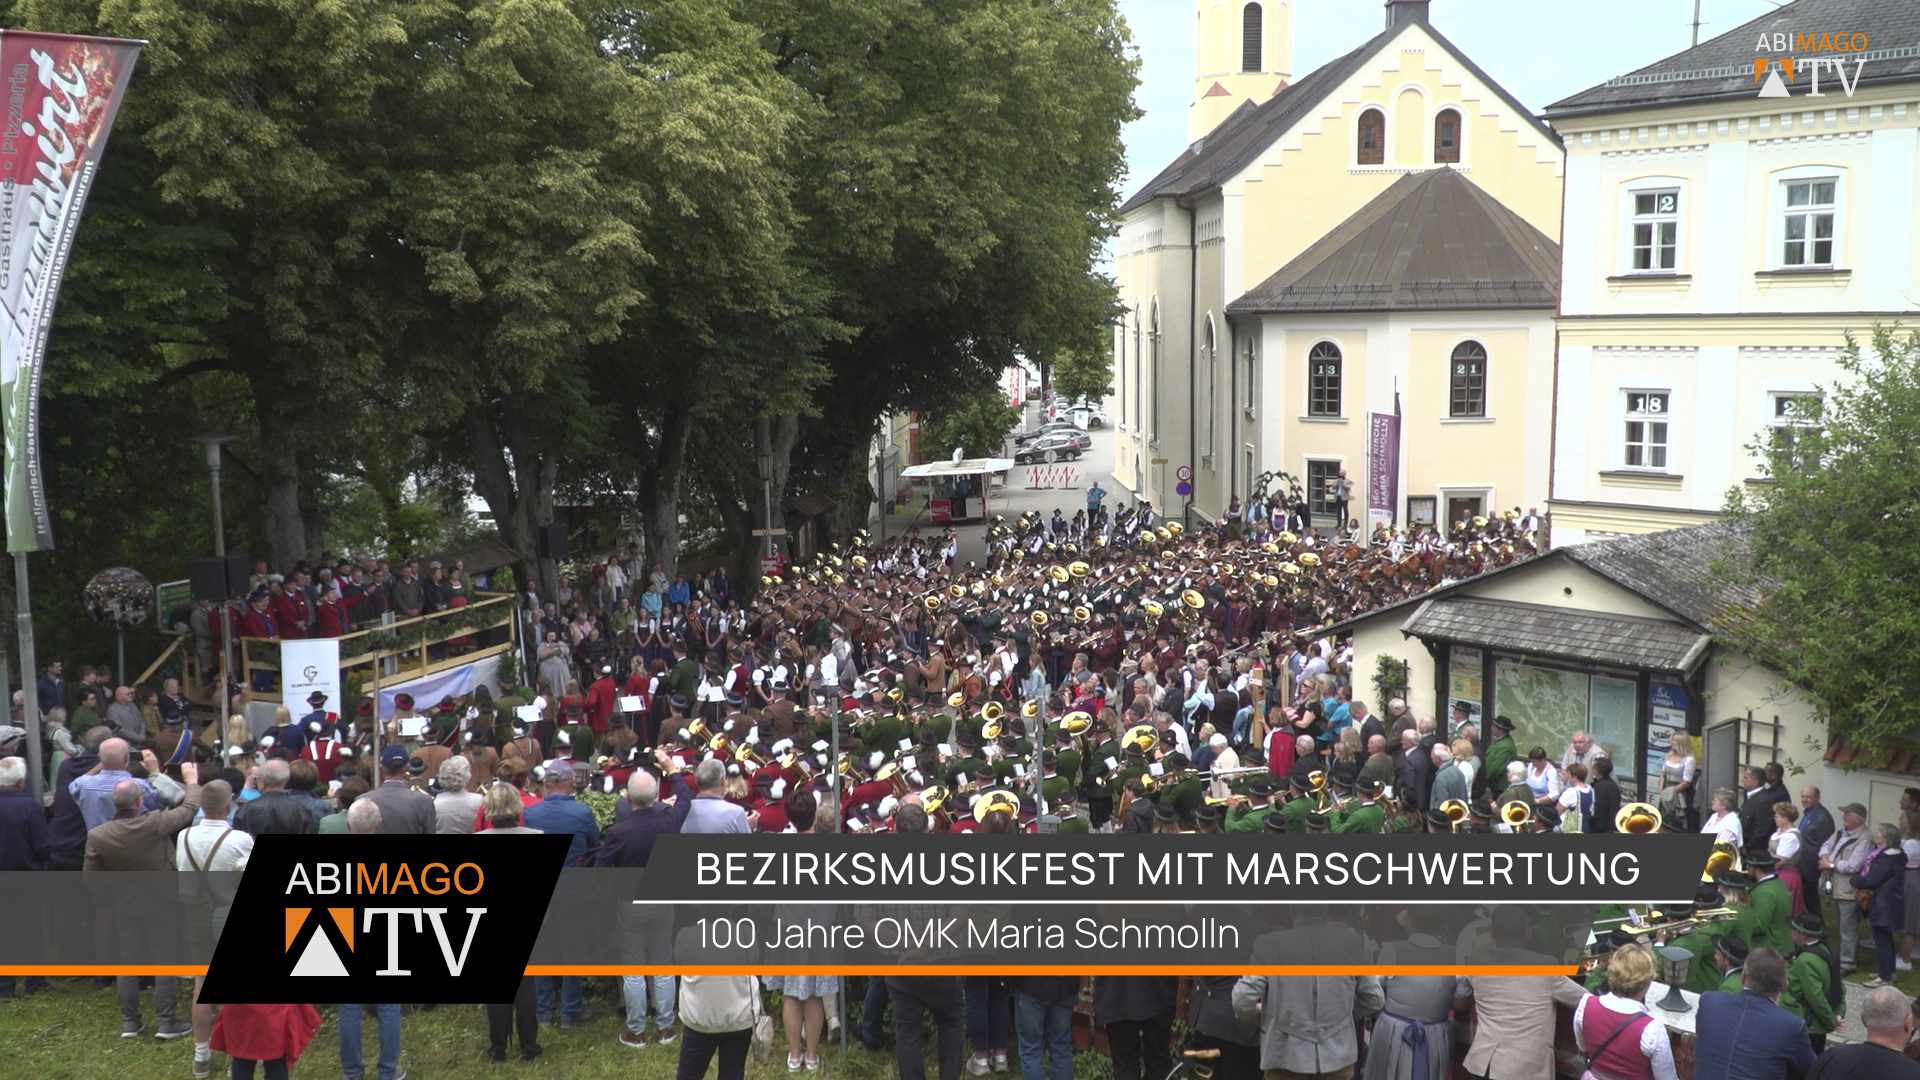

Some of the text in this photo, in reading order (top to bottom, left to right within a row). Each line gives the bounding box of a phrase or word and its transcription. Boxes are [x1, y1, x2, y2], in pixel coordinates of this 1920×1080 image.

[2, 64, 29, 154] Pizzeria
[1660, 194, 1675, 213] 2
[1317, 364, 1336, 375] 13
[1456, 363, 1477, 375] 21
[1635, 396, 1663, 413] 18
